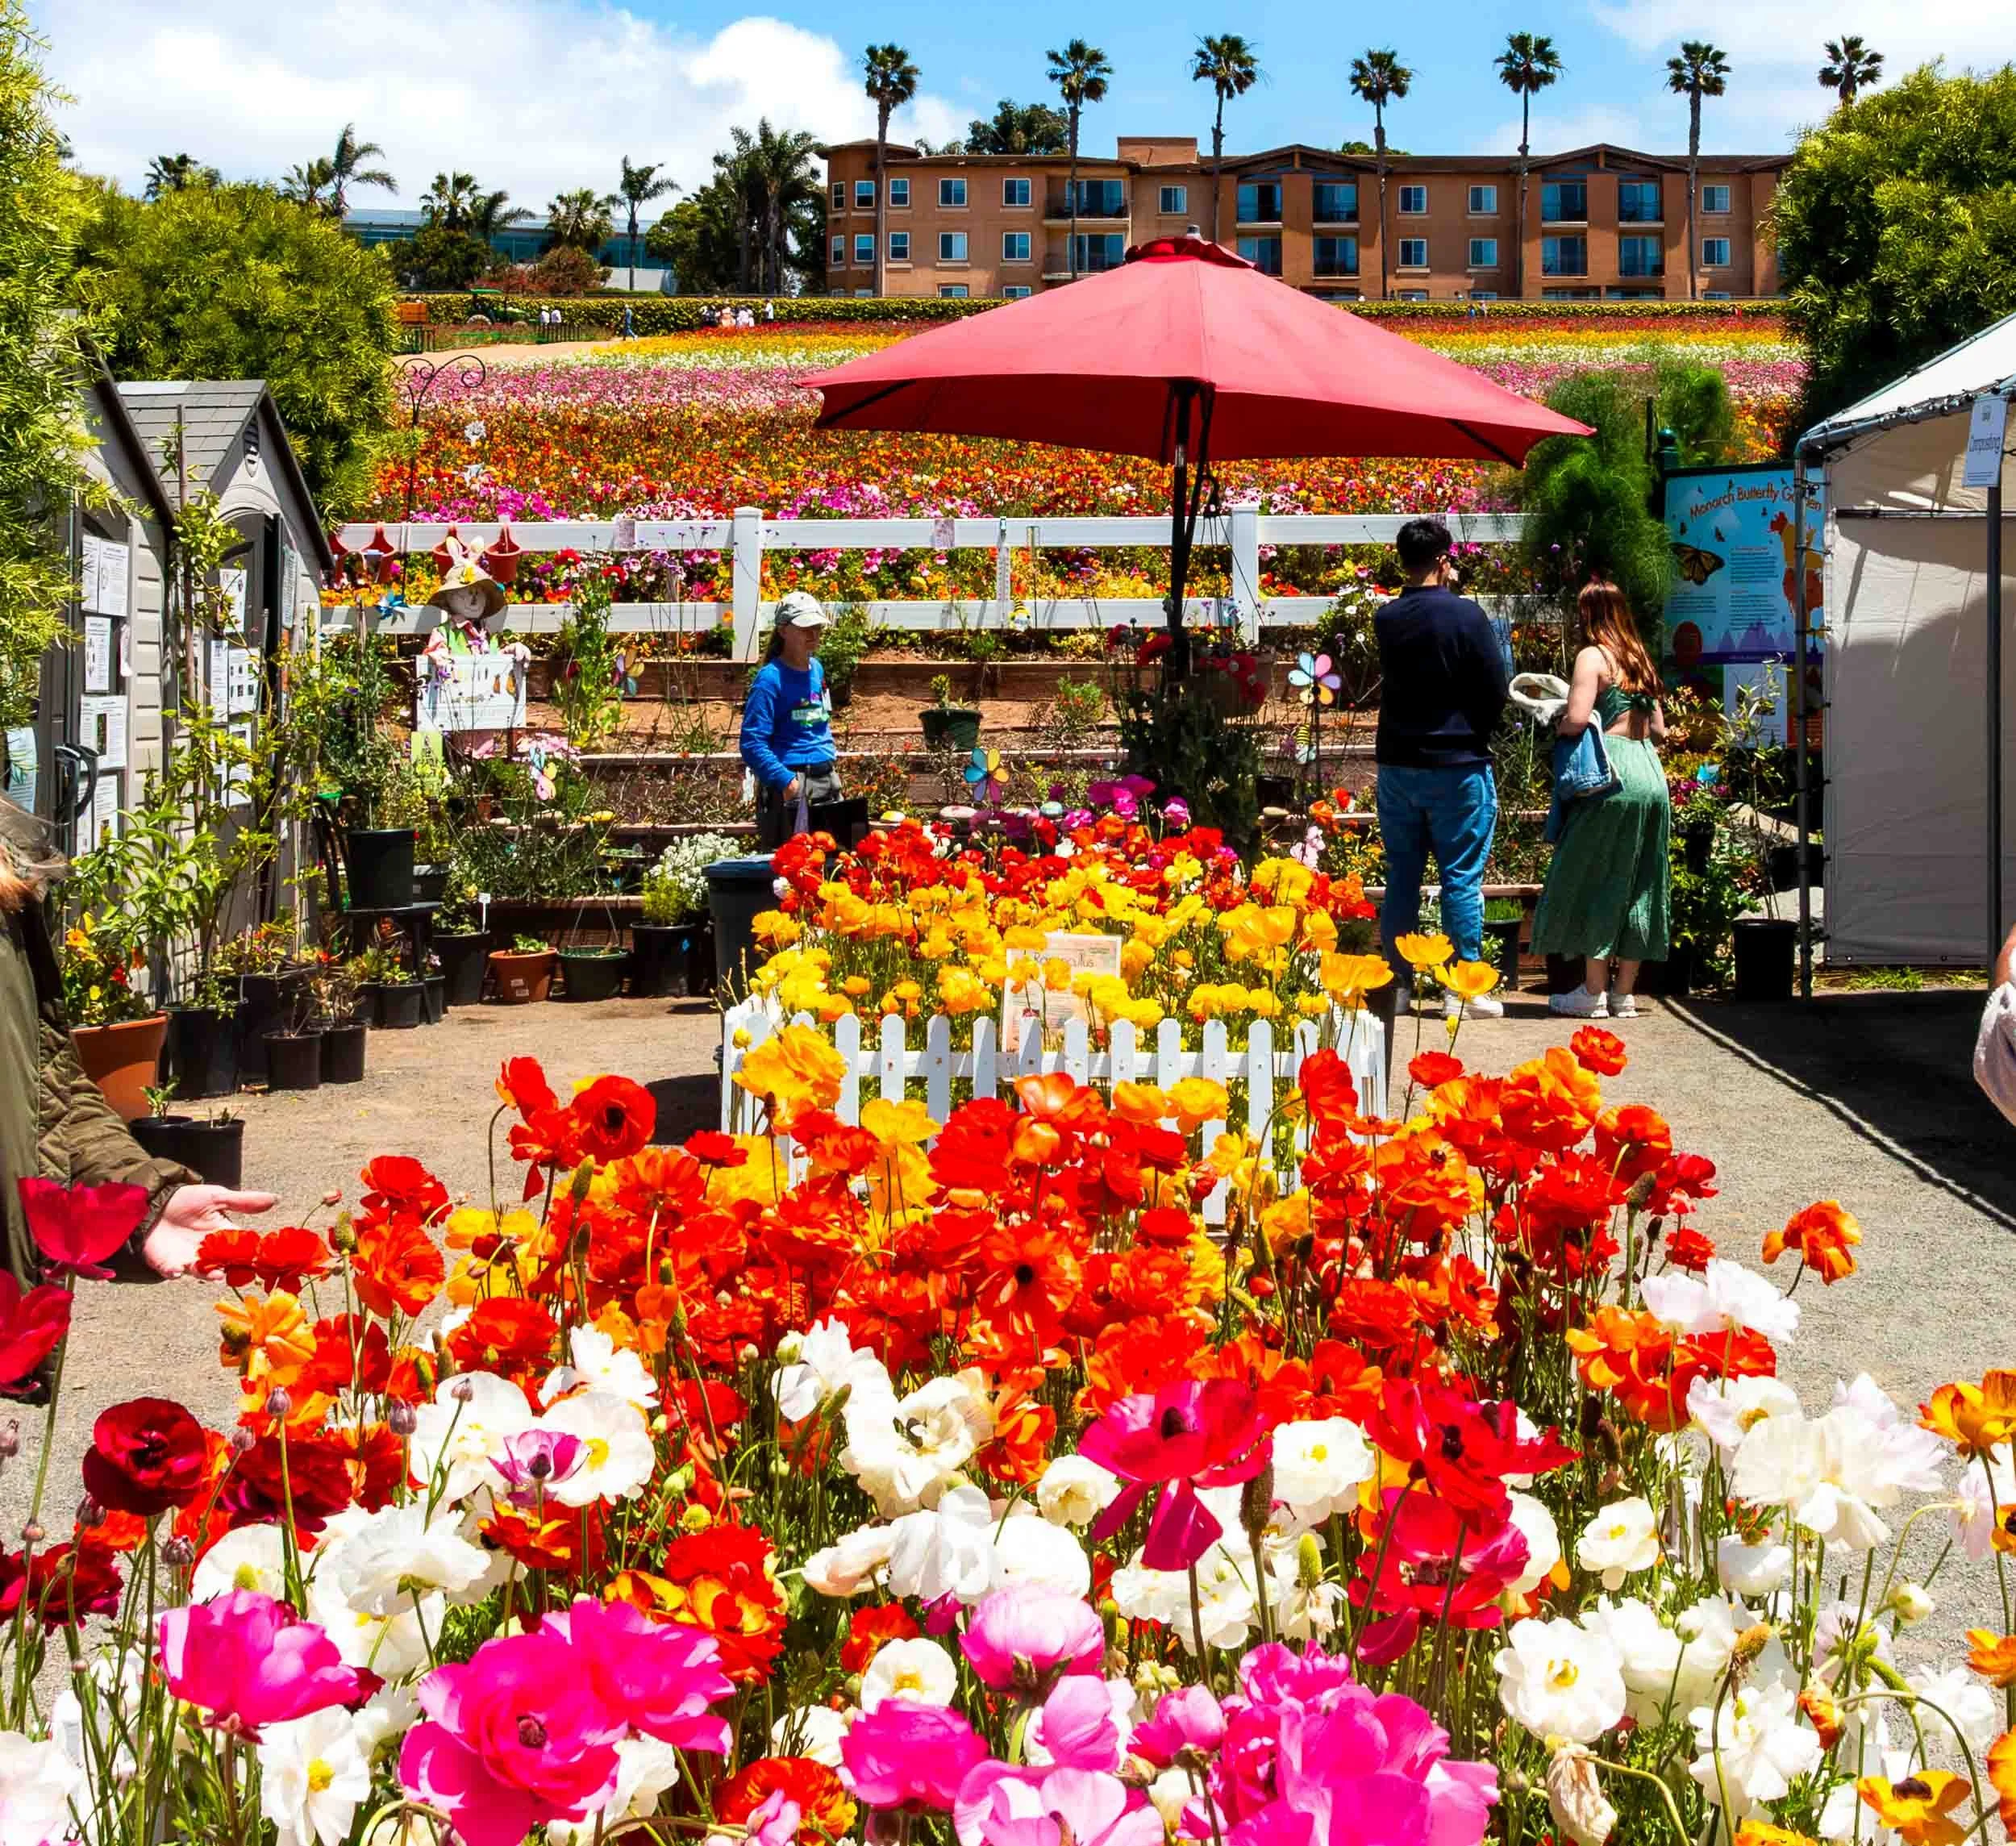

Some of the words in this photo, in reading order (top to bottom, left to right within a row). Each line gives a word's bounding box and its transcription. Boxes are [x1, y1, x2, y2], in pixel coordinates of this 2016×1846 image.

[1690, 490, 1735, 520] Monarch
[1737, 482, 1779, 502] Butterfly
[1781, 485, 1821, 510] Gaden
